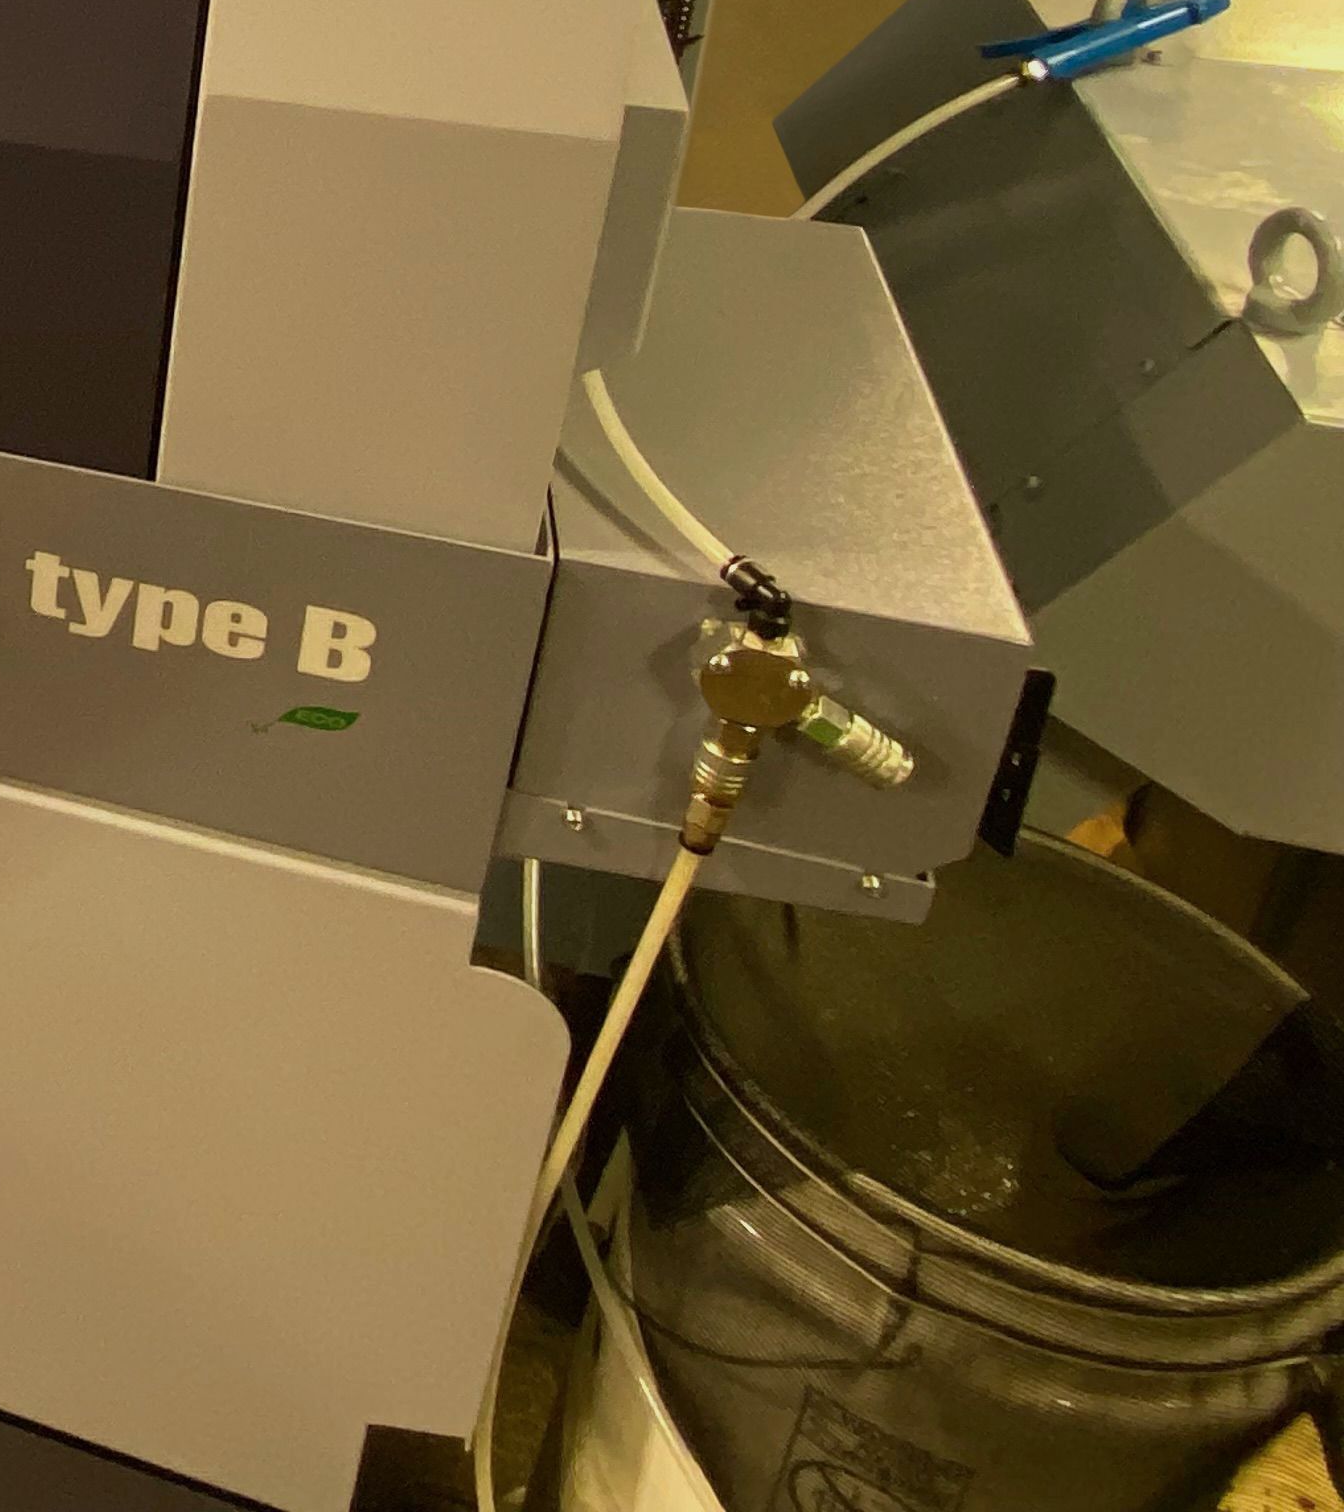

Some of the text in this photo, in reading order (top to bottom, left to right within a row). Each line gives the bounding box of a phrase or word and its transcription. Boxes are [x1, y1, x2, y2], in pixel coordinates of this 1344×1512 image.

[25, 530, 269, 659] type
[297, 604, 376, 683] B
[295, 709, 347, 729] ECO
